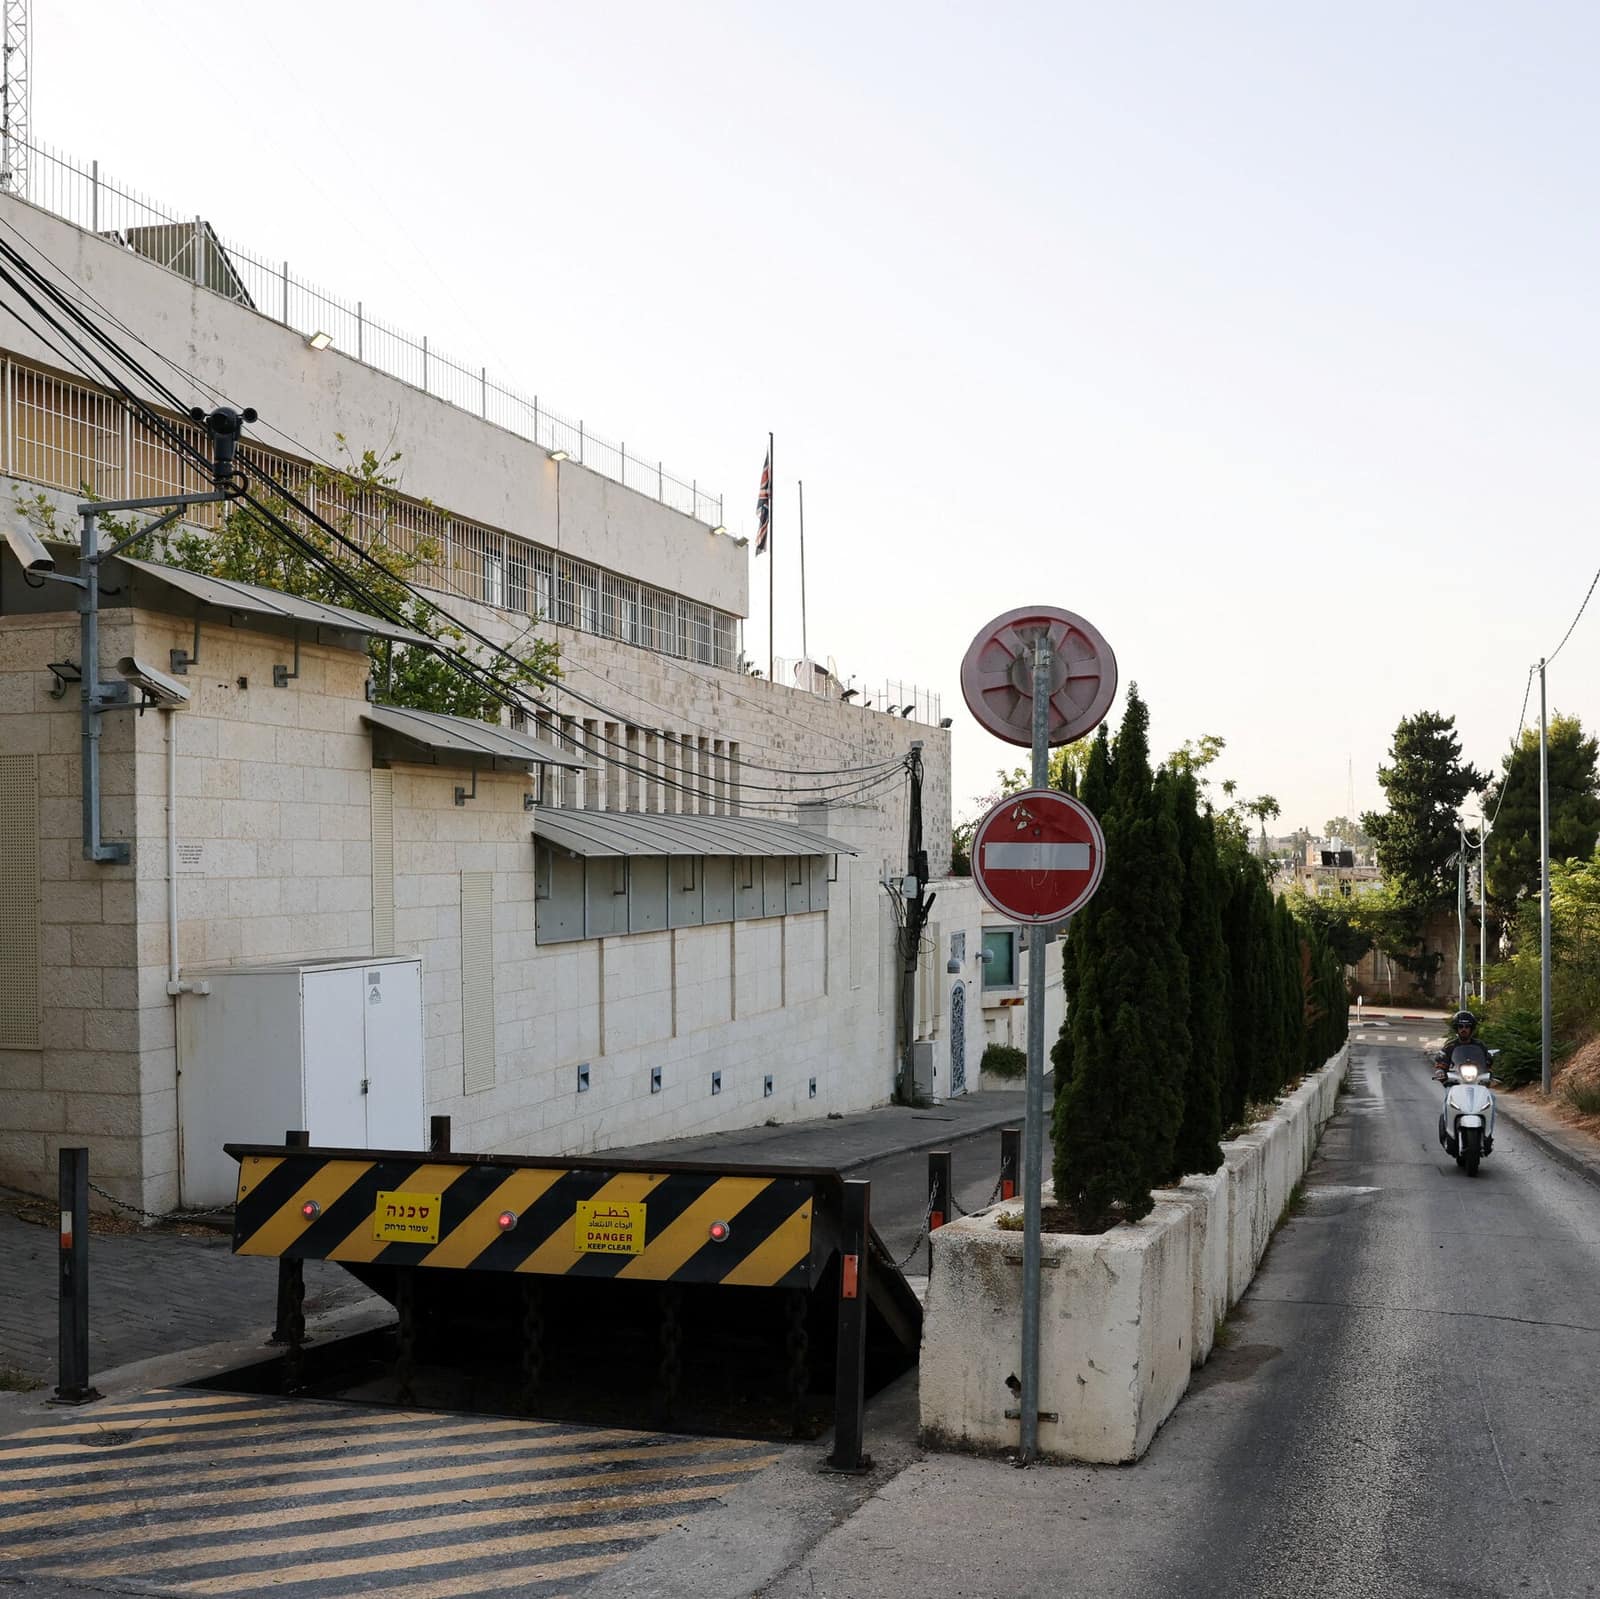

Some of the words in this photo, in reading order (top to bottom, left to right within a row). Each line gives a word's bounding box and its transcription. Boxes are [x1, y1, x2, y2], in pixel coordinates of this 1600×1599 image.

[386, 1204, 430, 1219] סכנה
[592, 1206, 630, 1219] خطر
[384, 1223, 406, 1232] מרחק
[408, 1223, 428, 1232] שמור
[614, 1221, 633, 1230] الرجاء
[587, 1232, 633, 1242] DANGER
[587, 1242, 606, 1250] KEEP
[607, 1243, 632, 1251] CLEAR
